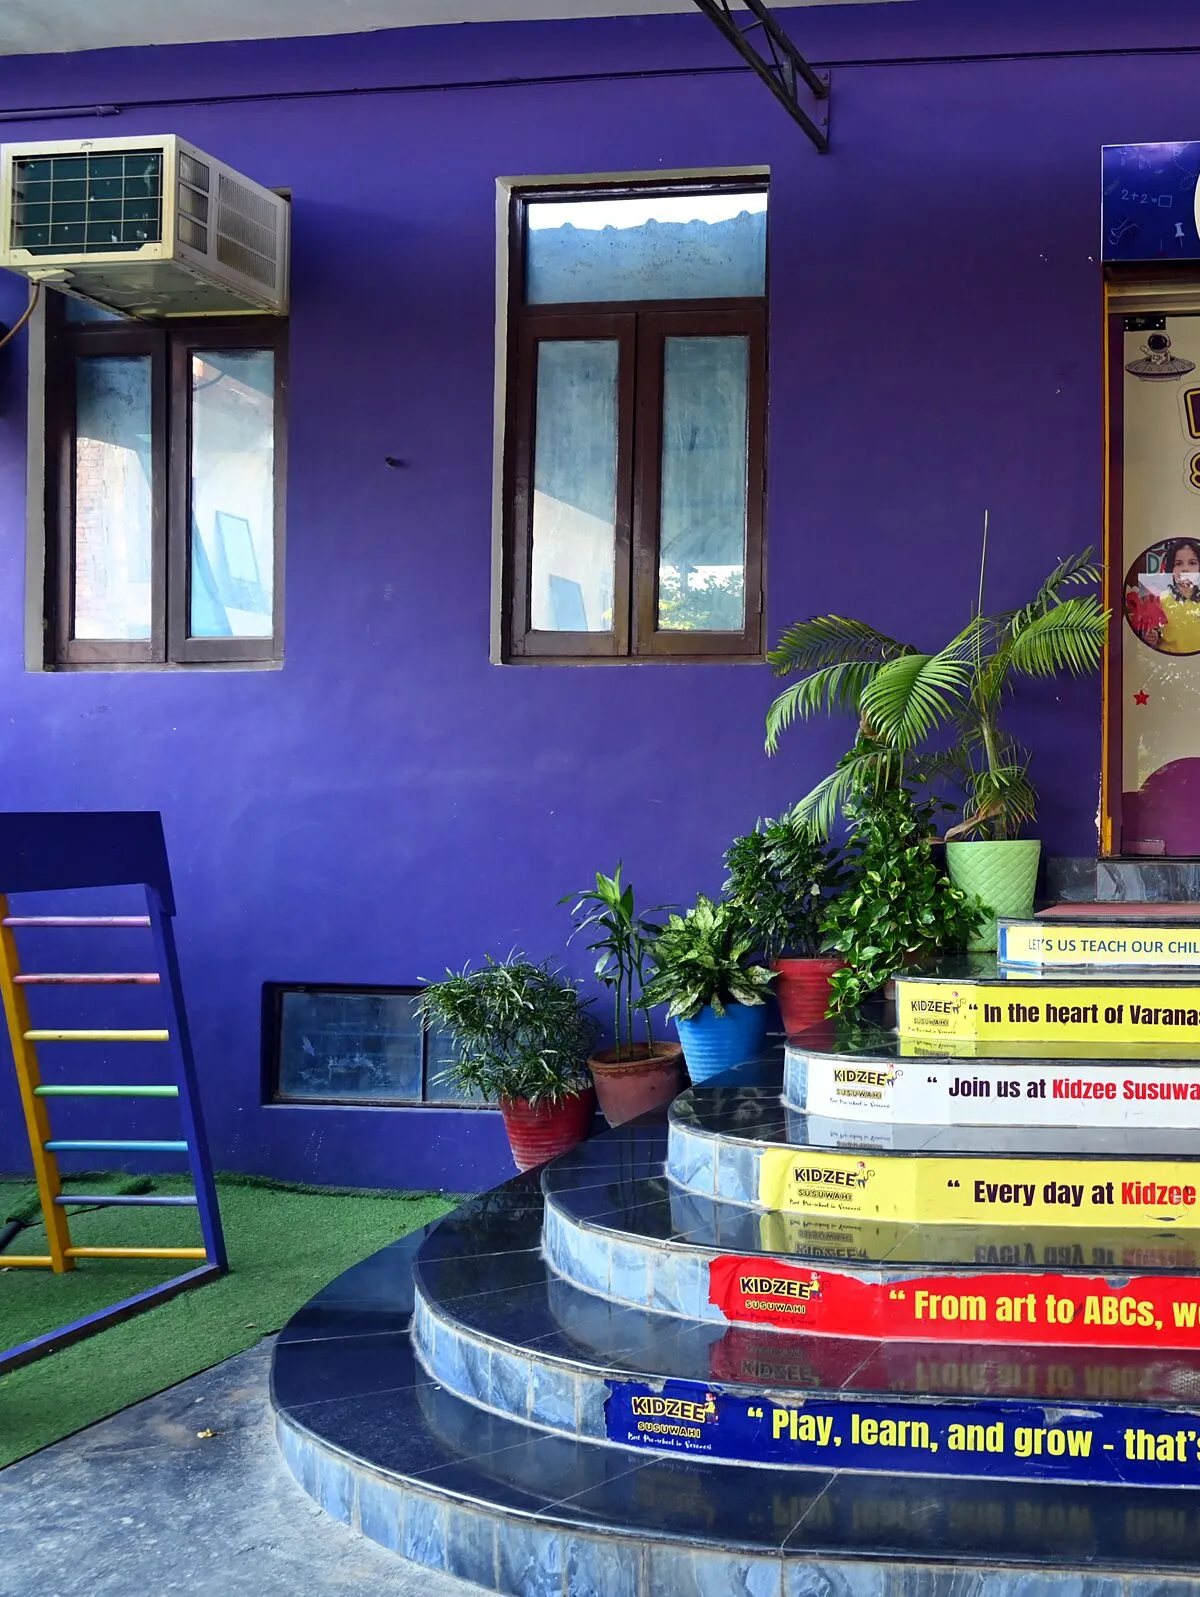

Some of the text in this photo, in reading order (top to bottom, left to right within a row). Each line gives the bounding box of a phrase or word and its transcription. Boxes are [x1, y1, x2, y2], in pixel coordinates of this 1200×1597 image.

[1058, 939, 1076, 952] US
[1080, 940, 1127, 953] TEACH
[1131, 940, 1164, 954] OUR
[911, 999, 951, 1014] KIDZEE
[984, 1003, 1002, 1023] In
[1007, 1003, 1040, 1023] the
[1045, 1003, 1099, 1024] heart
[1104, 1004, 1124, 1024] of
[833, 1067, 886, 1087] KIDZEE
[948, 1076, 991, 1098] Join
[997, 1080, 1020, 1097] us
[1026, 1078, 1047, 1099] at
[1052, 1078, 1117, 1100] Kidzee
[794, 1167, 857, 1189] KIDZEE
[798, 1188, 853, 1202] SUSUWAHI
[974, 1180, 1036, 1207] Every
[1043, 1181, 1085, 1208] day
[1091, 1181, 1115, 1205] at
[1121, 1181, 1197, 1206] Kidzee
[740, 1277, 811, 1300] KIDZEE
[745, 1300, 806, 1314] SUSUWAHI
[914, 1290, 987, 1321] From
[995, 1293, 1037, 1323] art
[1045, 1294, 1075, 1324] to
[1083, 1295, 1163, 1330] ABCs,
[632, 1397, 706, 1423] KIDZEE
[638, 1421, 701, 1438] SUSUWAHI
[774, 1409, 841, 1445] Play,
[852, 1413, 939, 1451] learn,
[949, 1421, 1004, 1453] and
[1015, 1427, 1093, 1458] grow
